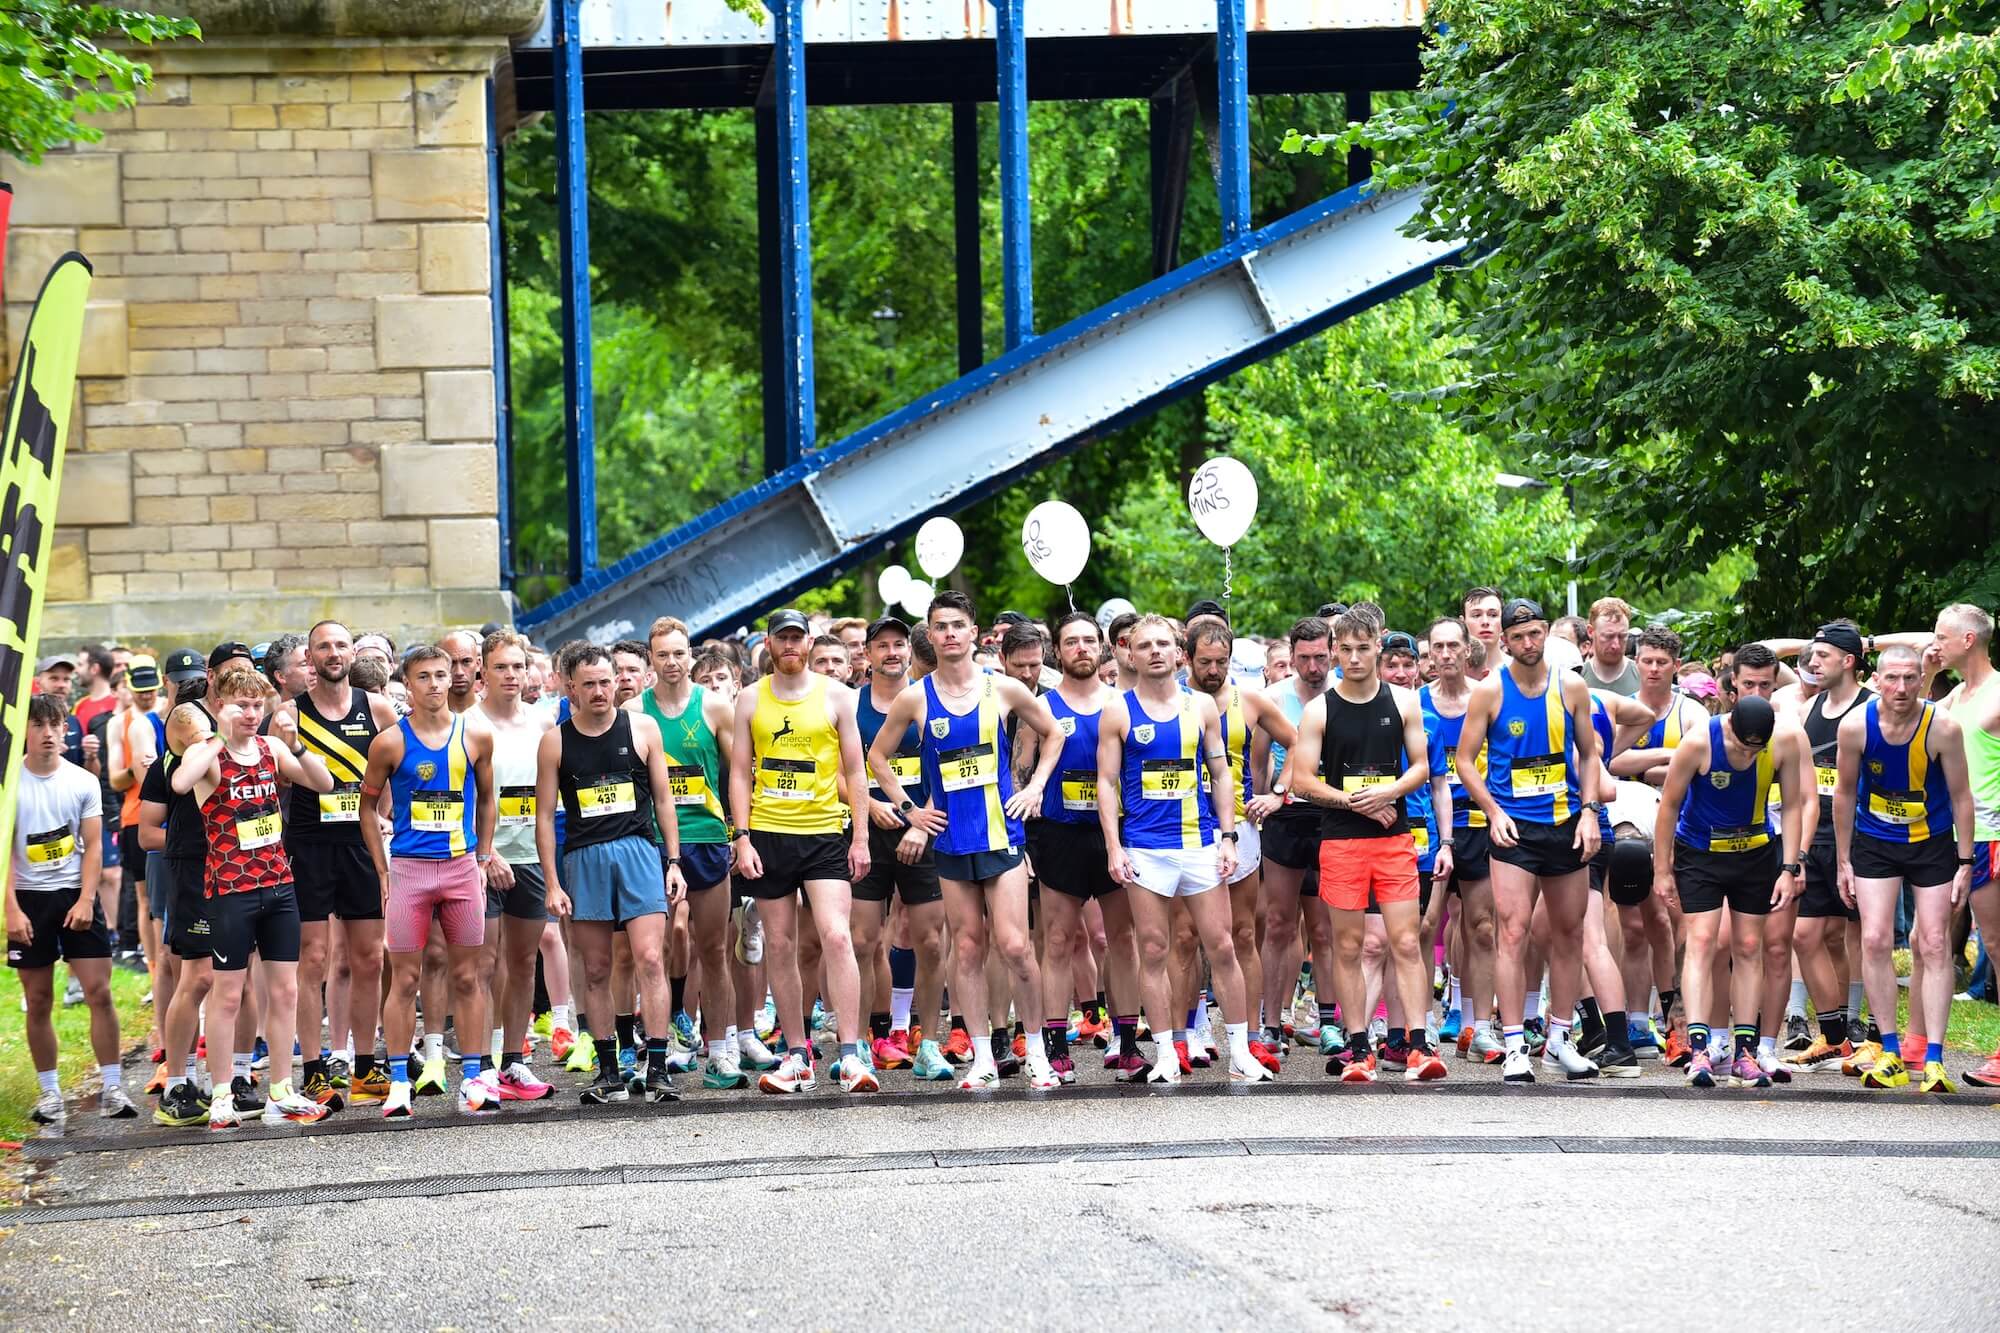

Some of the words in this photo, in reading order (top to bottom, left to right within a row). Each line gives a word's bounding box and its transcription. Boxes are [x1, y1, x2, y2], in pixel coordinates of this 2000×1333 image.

[1189, 488, 1230, 517] MINS
[1029, 519, 1040, 541] 0
[1025, 539, 1052, 565] INS
[780, 736, 812, 744] mercia
[958, 758, 978, 768] JAMES
[779, 771, 795, 779] JACK
[959, 765, 980, 778] 273
[777, 778, 797, 791] 1221
[1161, 779, 1181, 790] 597
[1534, 774, 1547, 785] 77
[593, 785, 618, 795] THOMAS
[1079, 790, 1098, 801] 114
[597, 792, 617, 804] 430
[340, 801, 357, 811] 813
[426, 802, 452, 810] RICHARD
[520, 804, 531, 816] 84
[1885, 805, 1908, 817] 1252
[433, 810, 446, 821] 111
[255, 823, 274, 837] 1069
